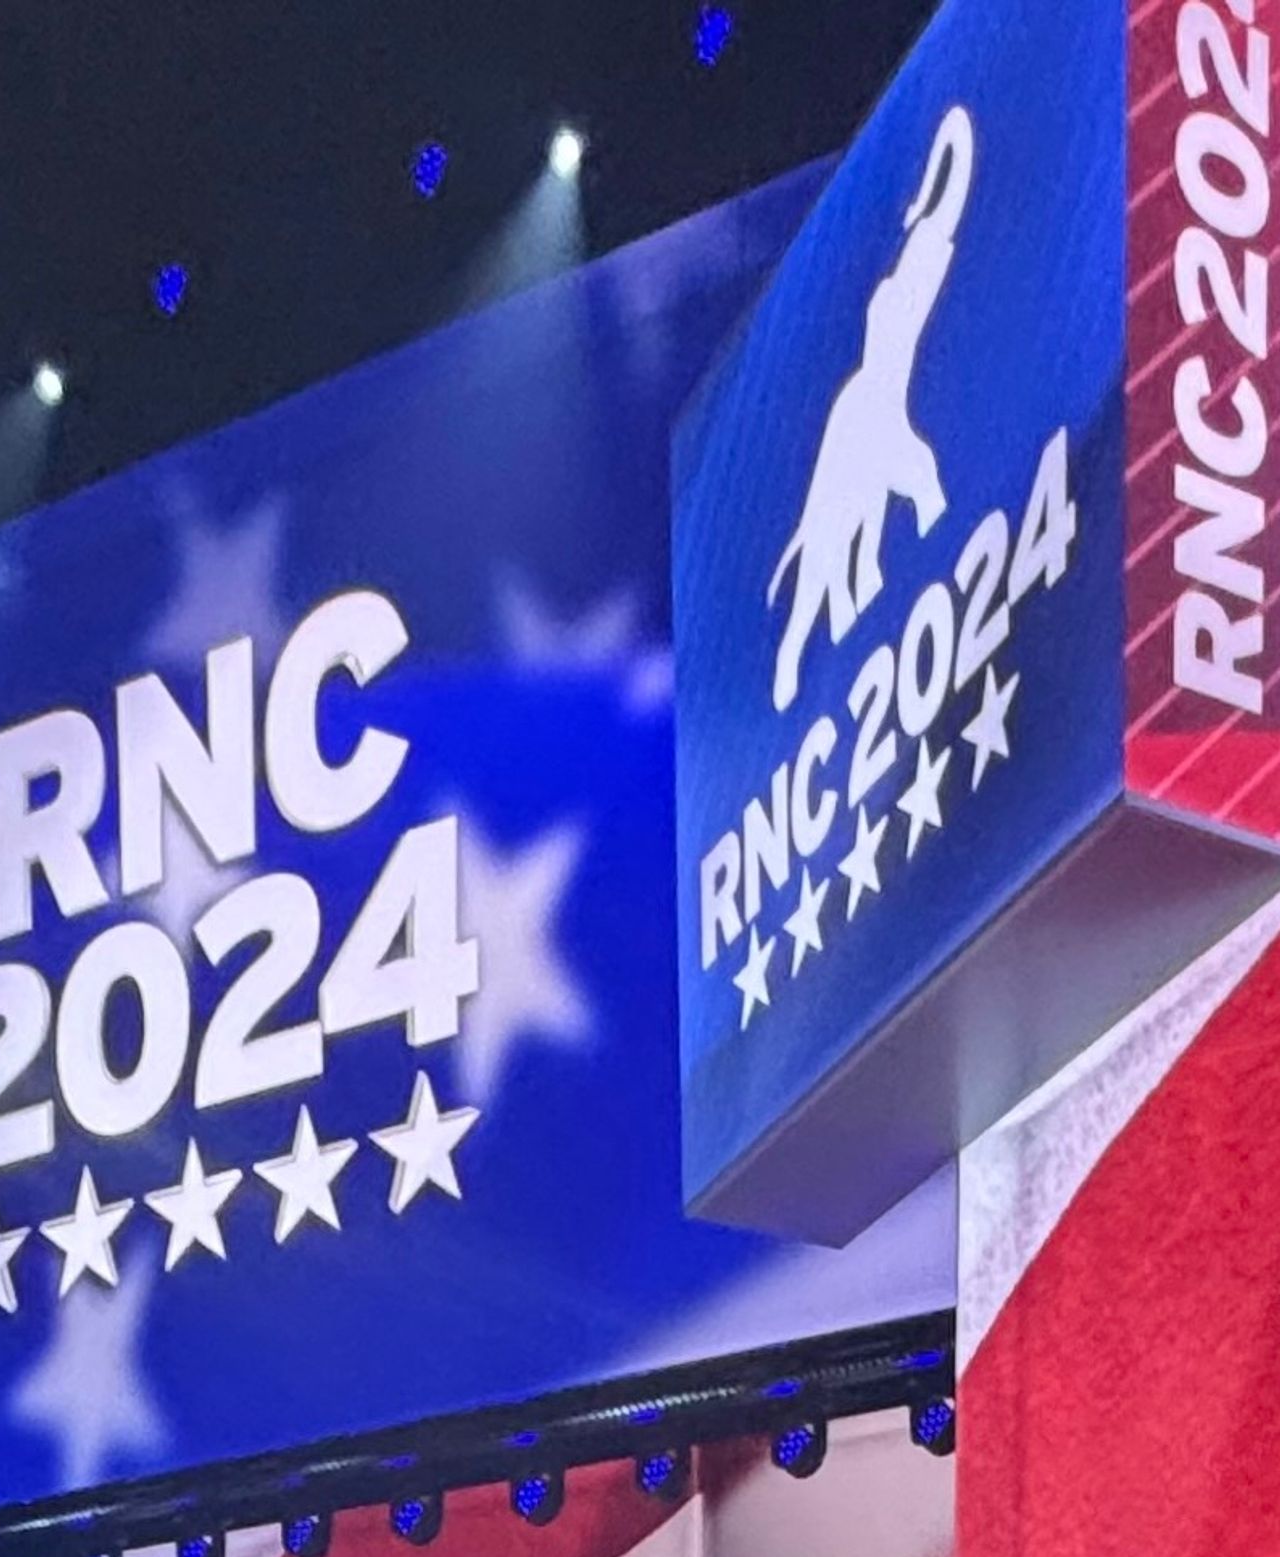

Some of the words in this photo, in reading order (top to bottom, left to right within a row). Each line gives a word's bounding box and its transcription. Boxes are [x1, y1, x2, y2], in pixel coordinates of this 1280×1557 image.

[1175, 0, 1271, 359] 202
[701, 716, 839, 970] RNC
[848, 426, 1076, 809] 2024
[1174, 356, 1268, 715] RNC
